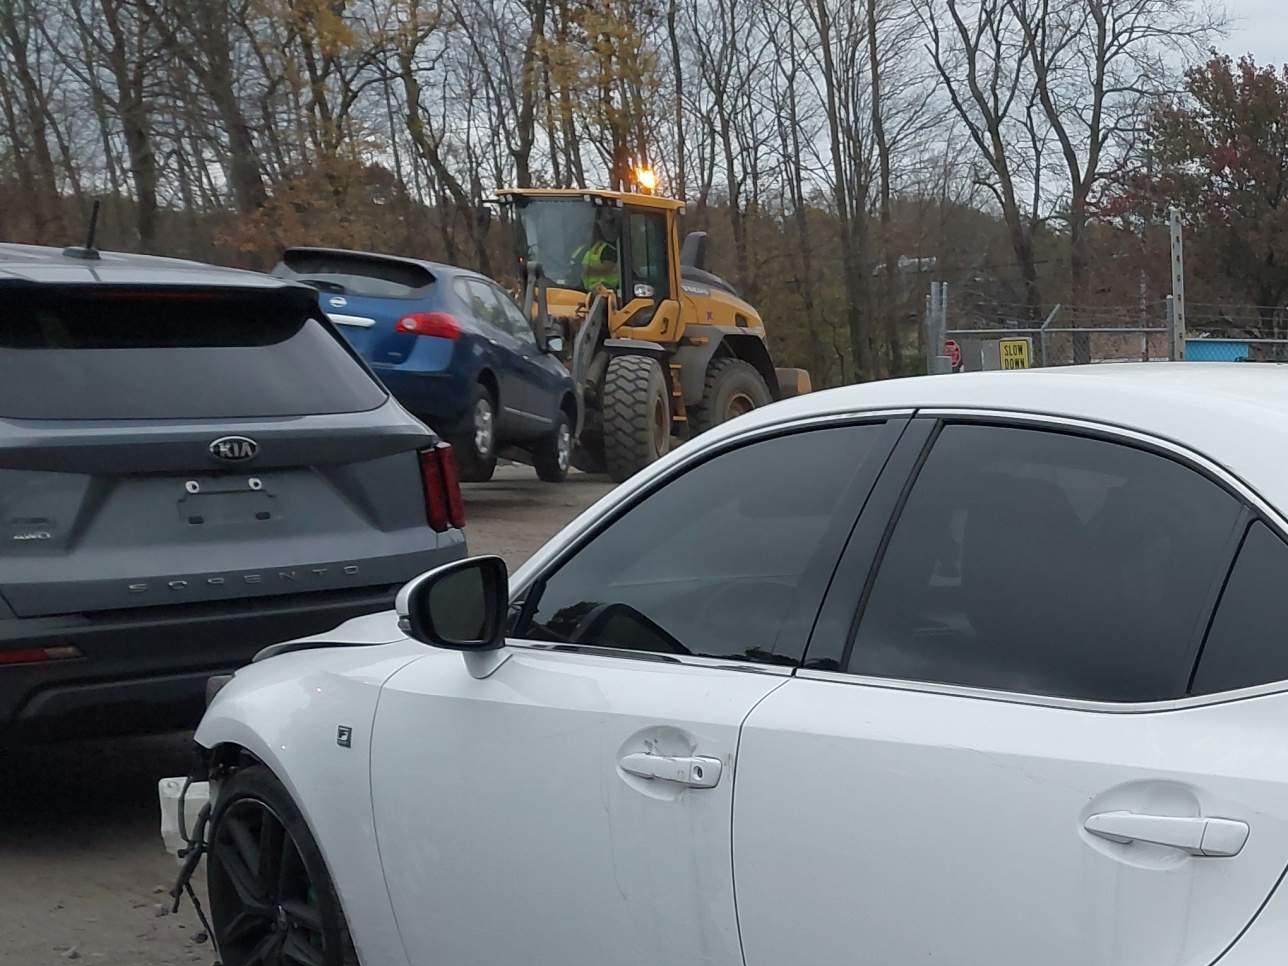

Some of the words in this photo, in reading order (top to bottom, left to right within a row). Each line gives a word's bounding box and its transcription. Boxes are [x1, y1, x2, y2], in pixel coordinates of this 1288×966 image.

[1003, 345, 1024, 356] SLOW
[1004, 359, 1025, 369] DOWN
[218, 442, 253, 457] KIA
[128, 564, 360, 592] SORENTO
